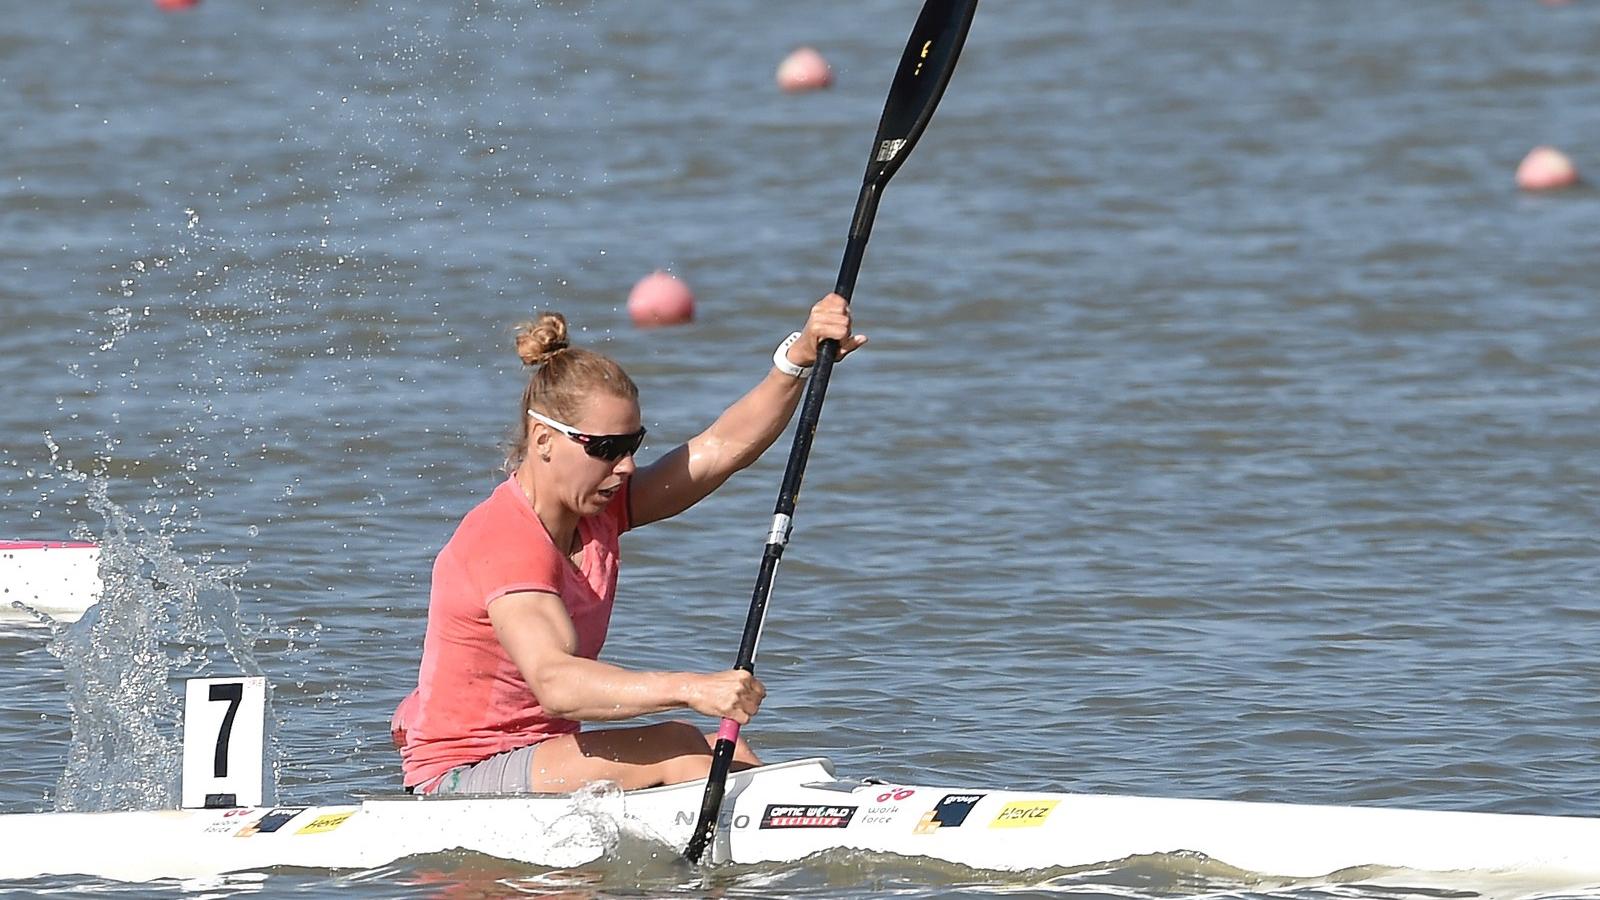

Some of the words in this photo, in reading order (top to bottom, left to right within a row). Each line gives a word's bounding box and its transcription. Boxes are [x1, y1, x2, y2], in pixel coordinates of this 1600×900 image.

[208, 683, 243, 778] 7
[943, 795, 980, 805] group
[770, 807, 806, 817] OPTIC
[868, 805, 899, 814] work
[998, 806, 1050, 821] Hertz
